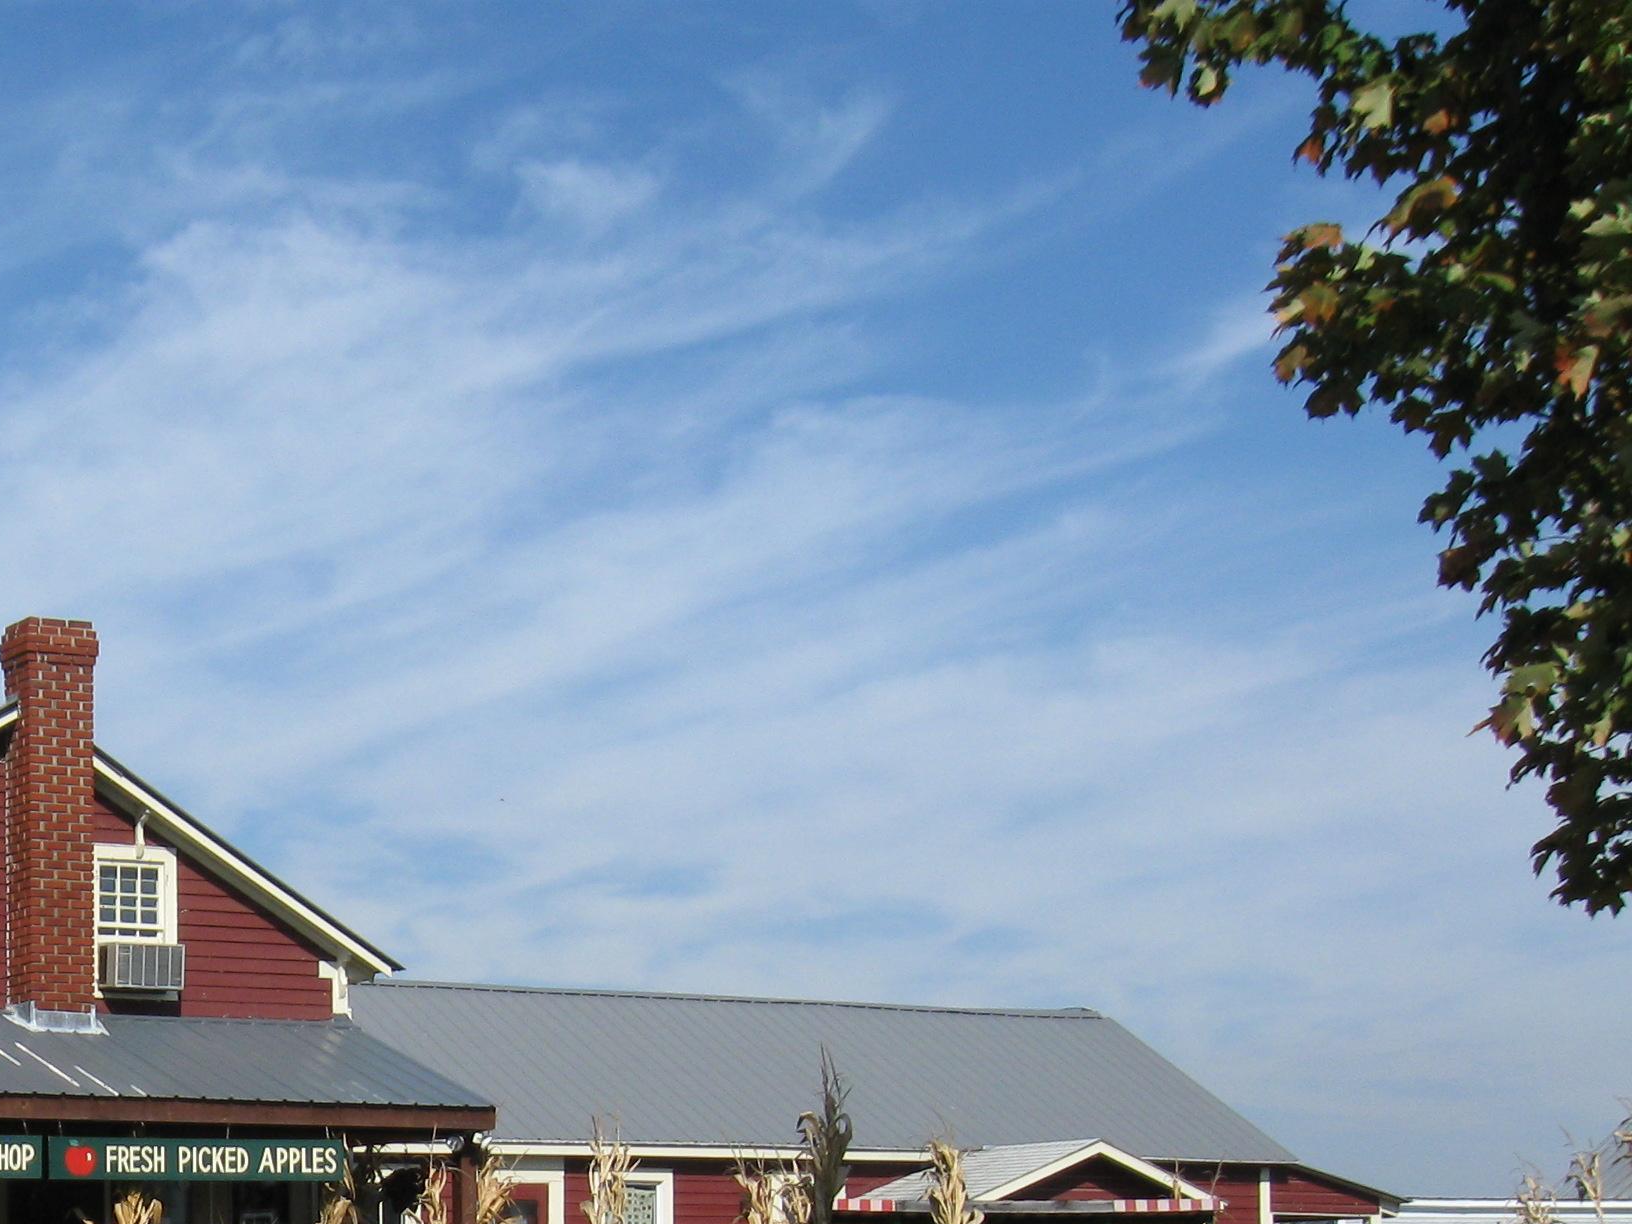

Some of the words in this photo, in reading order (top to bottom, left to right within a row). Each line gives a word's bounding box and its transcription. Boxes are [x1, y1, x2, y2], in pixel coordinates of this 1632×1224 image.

[105, 1145, 166, 1174] FRESH
[178, 1145, 249, 1174] PICKED
[257, 1146, 337, 1175] APPLES
